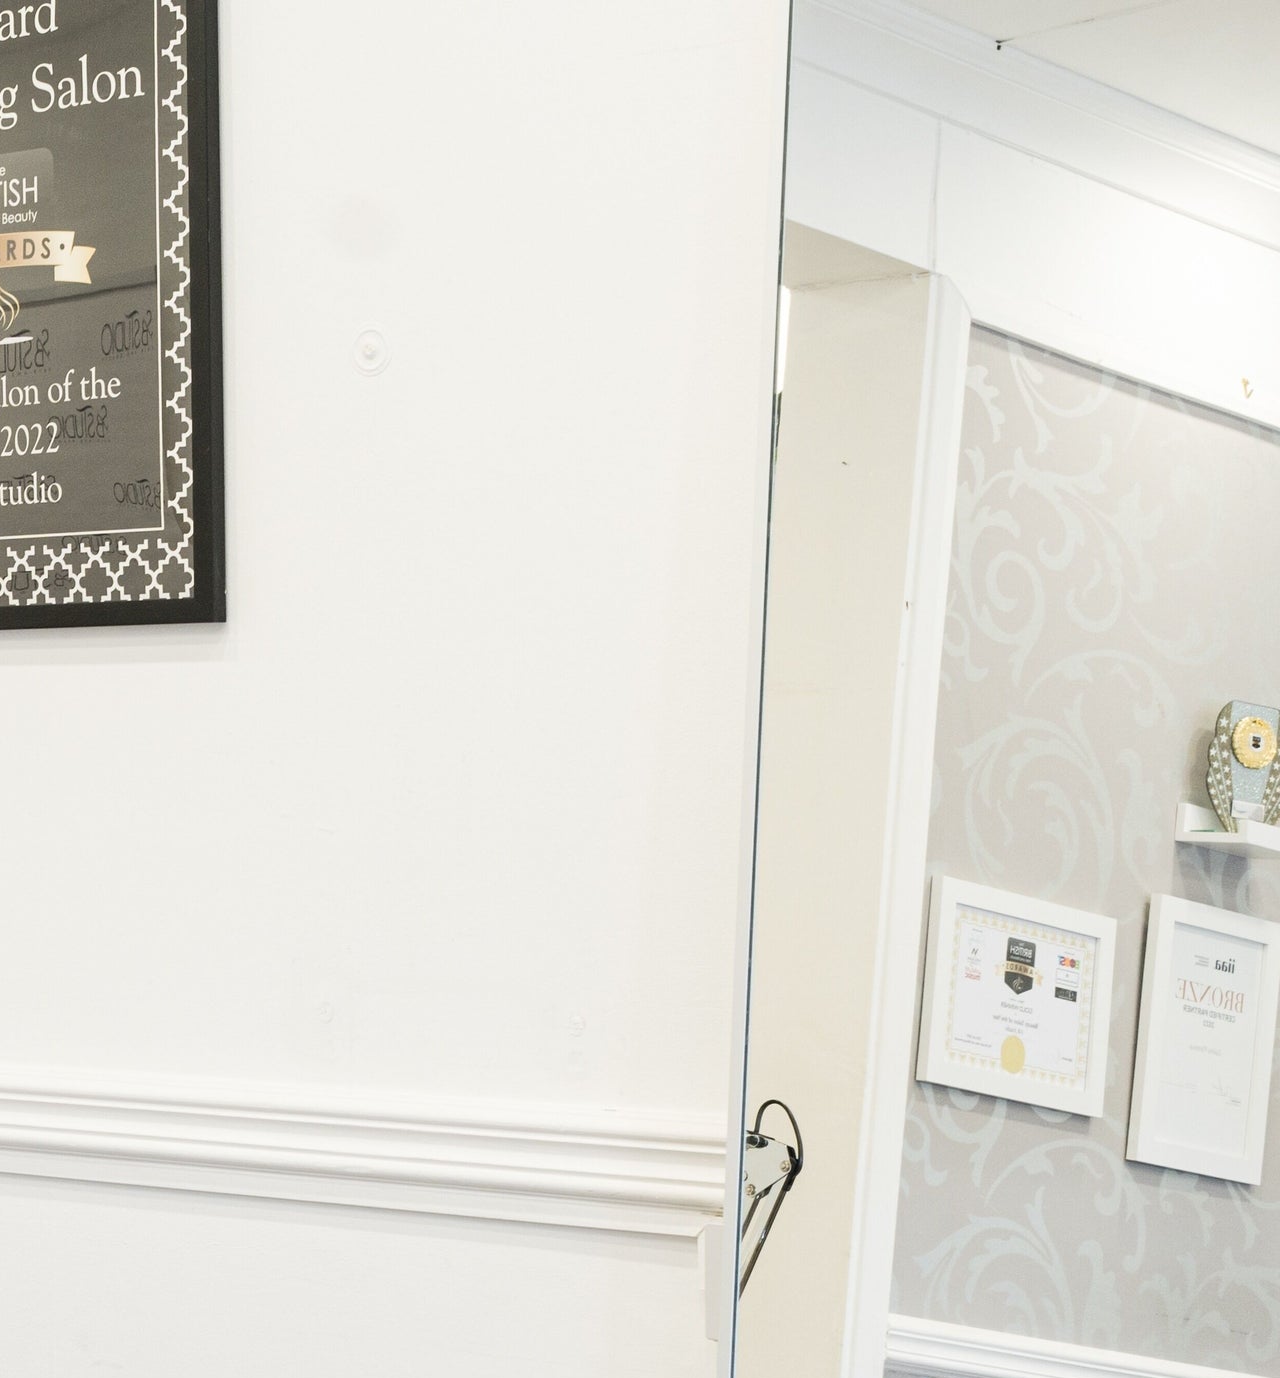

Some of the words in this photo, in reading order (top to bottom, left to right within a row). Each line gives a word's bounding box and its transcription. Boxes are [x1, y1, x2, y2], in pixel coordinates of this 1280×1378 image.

[31, 54, 145, 113] Salon
[2, 209, 38, 225] Beauty
[47, 368, 75, 403] of
[80, 367, 121, 400] the
[0, 421, 61, 457] 2022
